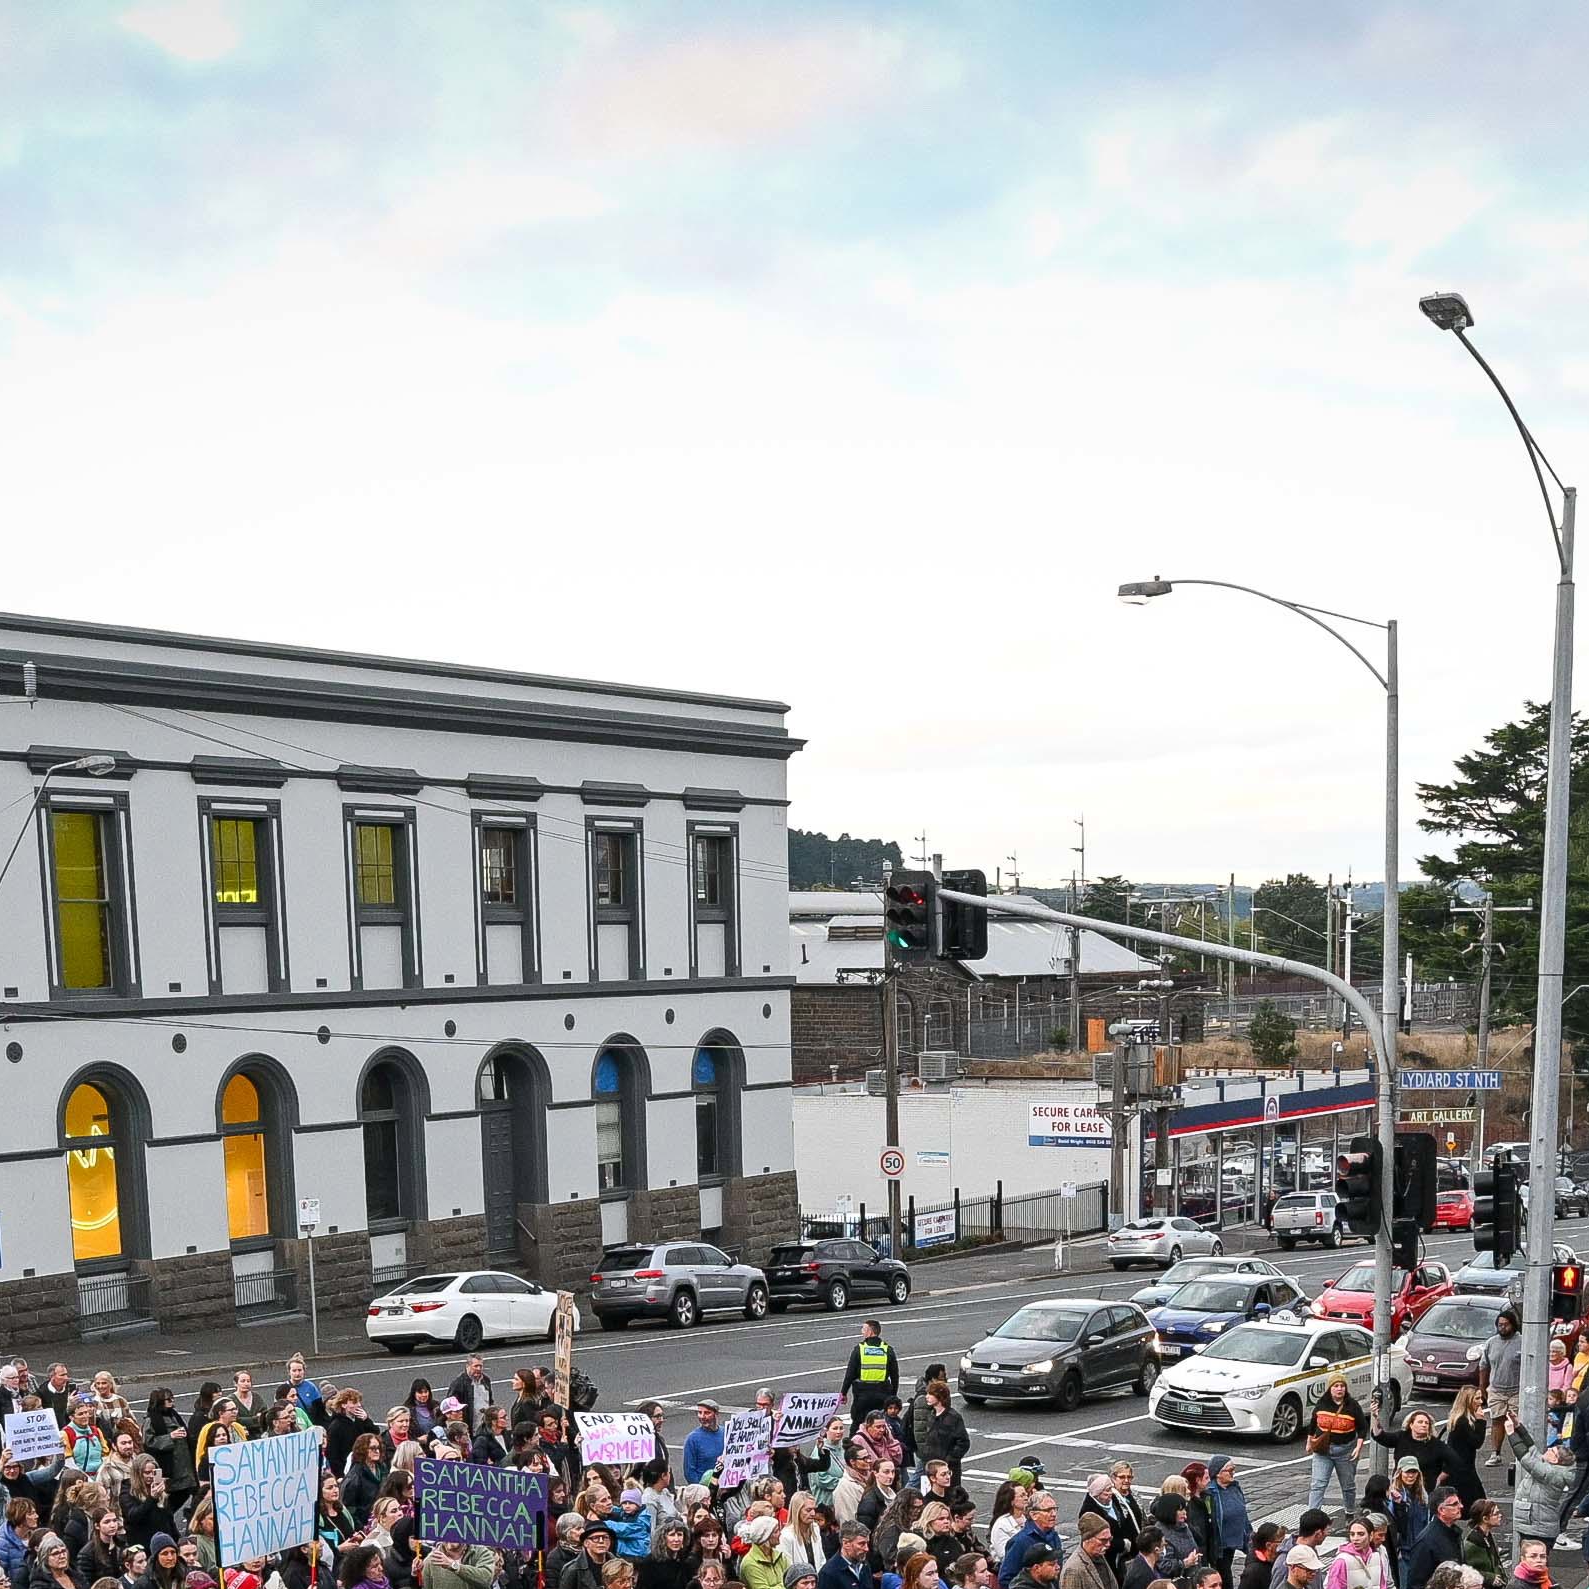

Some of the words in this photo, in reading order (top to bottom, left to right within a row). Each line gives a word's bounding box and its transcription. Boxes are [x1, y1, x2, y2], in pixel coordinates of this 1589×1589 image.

[1401, 1071, 1451, 1088] LYDIARD
[1455, 1072, 1471, 1088] ST
[1474, 1072, 1499, 1088] NTH
[1032, 1107, 1070, 1117] SECURE
[1411, 1111, 1428, 1122] ART
[1432, 1109, 1475, 1121] GALLERY
[1052, 1121, 1071, 1132] FOR
[1074, 1122, 1105, 1133] LEASE
[885, 1157, 901, 1169] 50
[788, 1395, 811, 1410] SAY
[26, 1414, 47, 1424] STOP
[580, 1414, 615, 1428] END
[622, 1414, 647, 1422] THE
[781, 1413, 830, 1431] NAMES
[586, 1424, 620, 1441] WAR
[627, 1424, 653, 1436] ON
[214, 1431, 320, 1486] SAMANTHA
[586, 1439, 653, 1463] WOMEN
[420, 1461, 543, 1499] SAMANTHA
[215, 1472, 310, 1522] REBECCA
[422, 1488, 533, 1525] REBECCA
[219, 1504, 315, 1562] HANNAH
[421, 1512, 537, 1549] HANNAH
